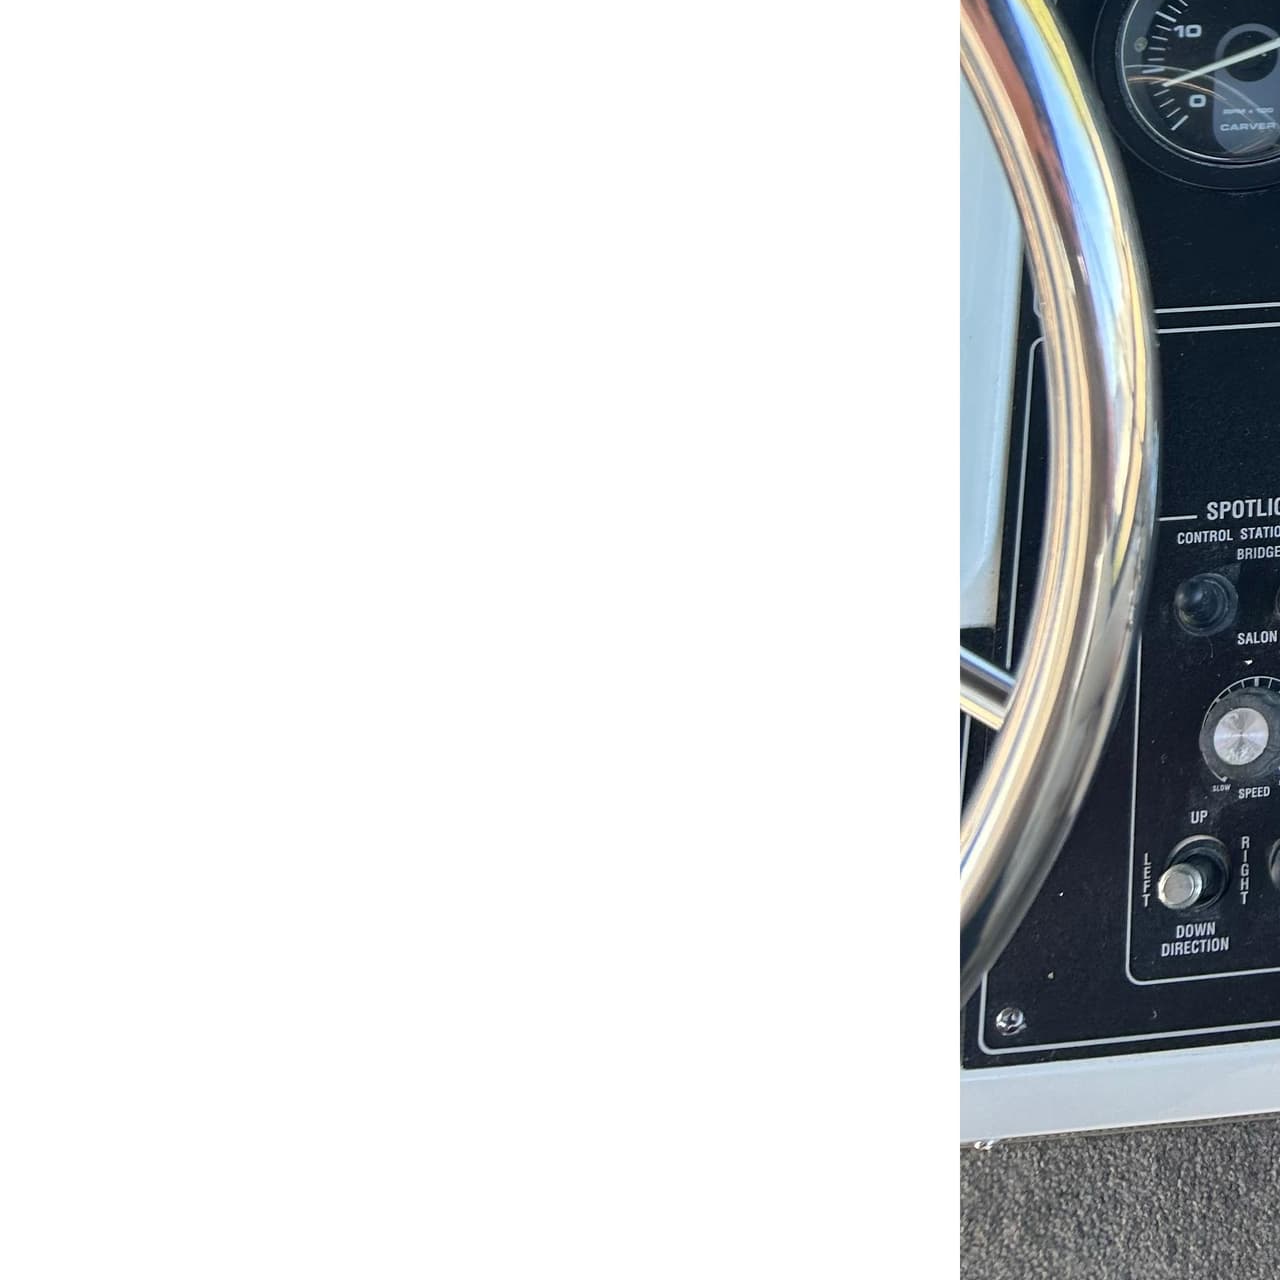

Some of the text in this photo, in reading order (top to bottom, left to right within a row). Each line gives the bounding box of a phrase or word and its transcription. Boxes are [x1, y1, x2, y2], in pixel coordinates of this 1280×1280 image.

[1173, 24, 1202, 38] 10
[1189, 94, 1207, 108] 0
[1220, 121, 1276, 132] CARVER
[1177, 529, 1233, 545] CONTROL
[1237, 630, 1278, 645] SALON
[1212, 783, 1231, 793] SLOW
[1238, 786, 1271, 799] SPEED
[1191, 809, 1208, 824] UP
[1240, 835, 1250, 905] RIGHT
[1142, 852, 1151, 908] LEFT
[1176, 921, 1216, 939] DOWN
[1161, 936, 1230, 958] DIRECTION
